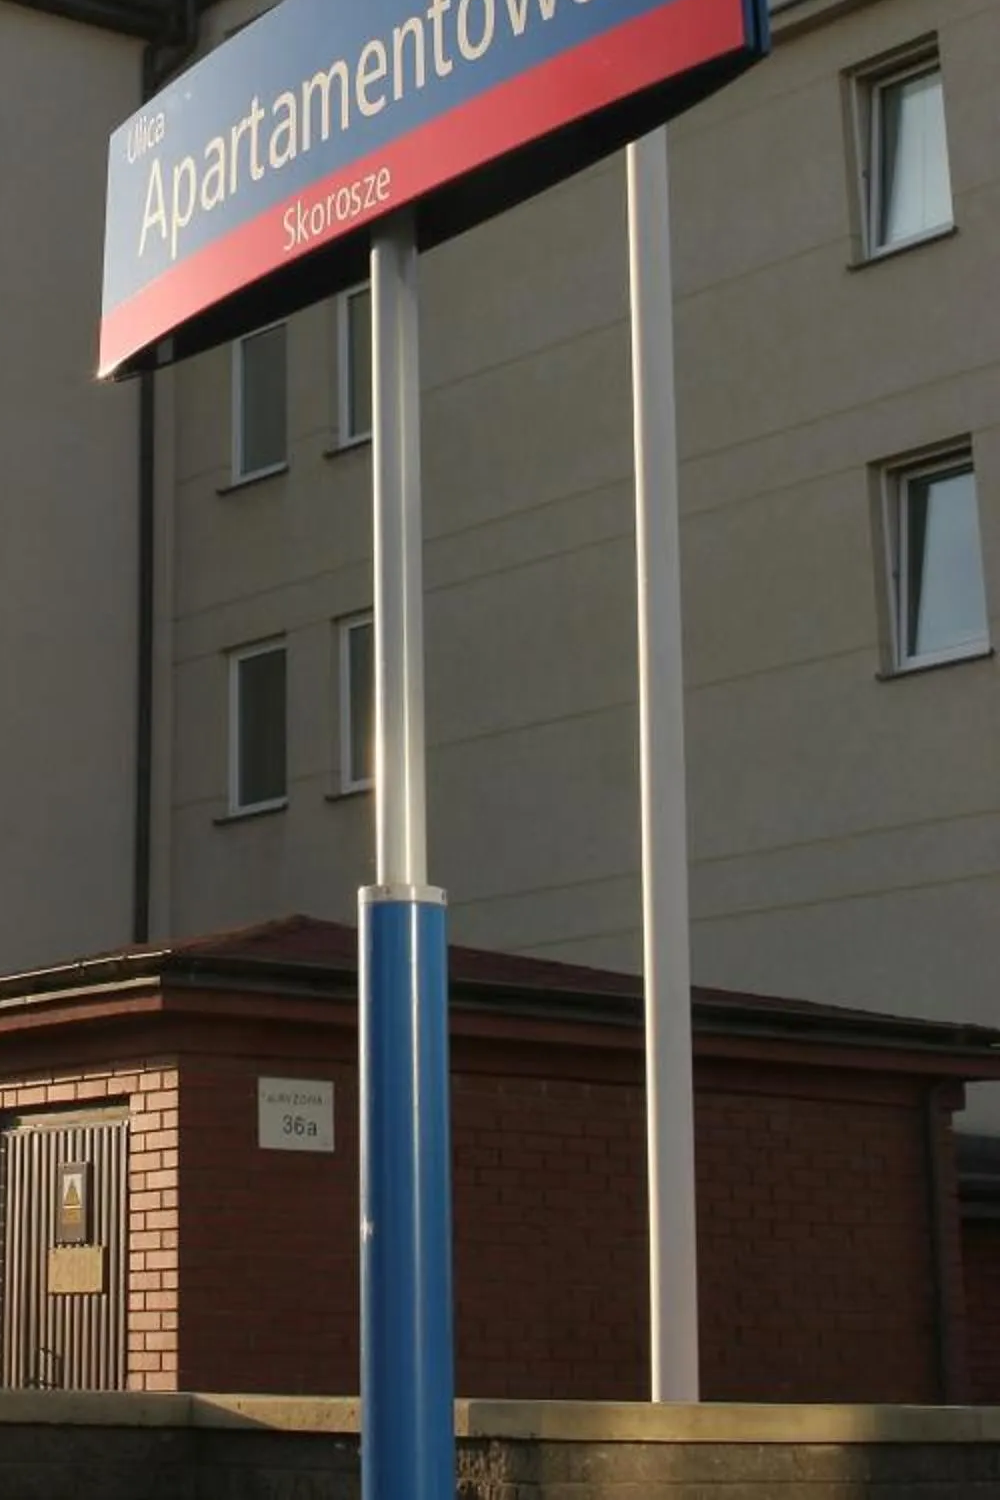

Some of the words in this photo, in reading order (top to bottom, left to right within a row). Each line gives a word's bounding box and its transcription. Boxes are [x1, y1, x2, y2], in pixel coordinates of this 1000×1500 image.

[127, 112, 165, 165] Ulica
[282, 166, 391, 252] Skorosze
[282, 1114, 318, 1137] 36a
